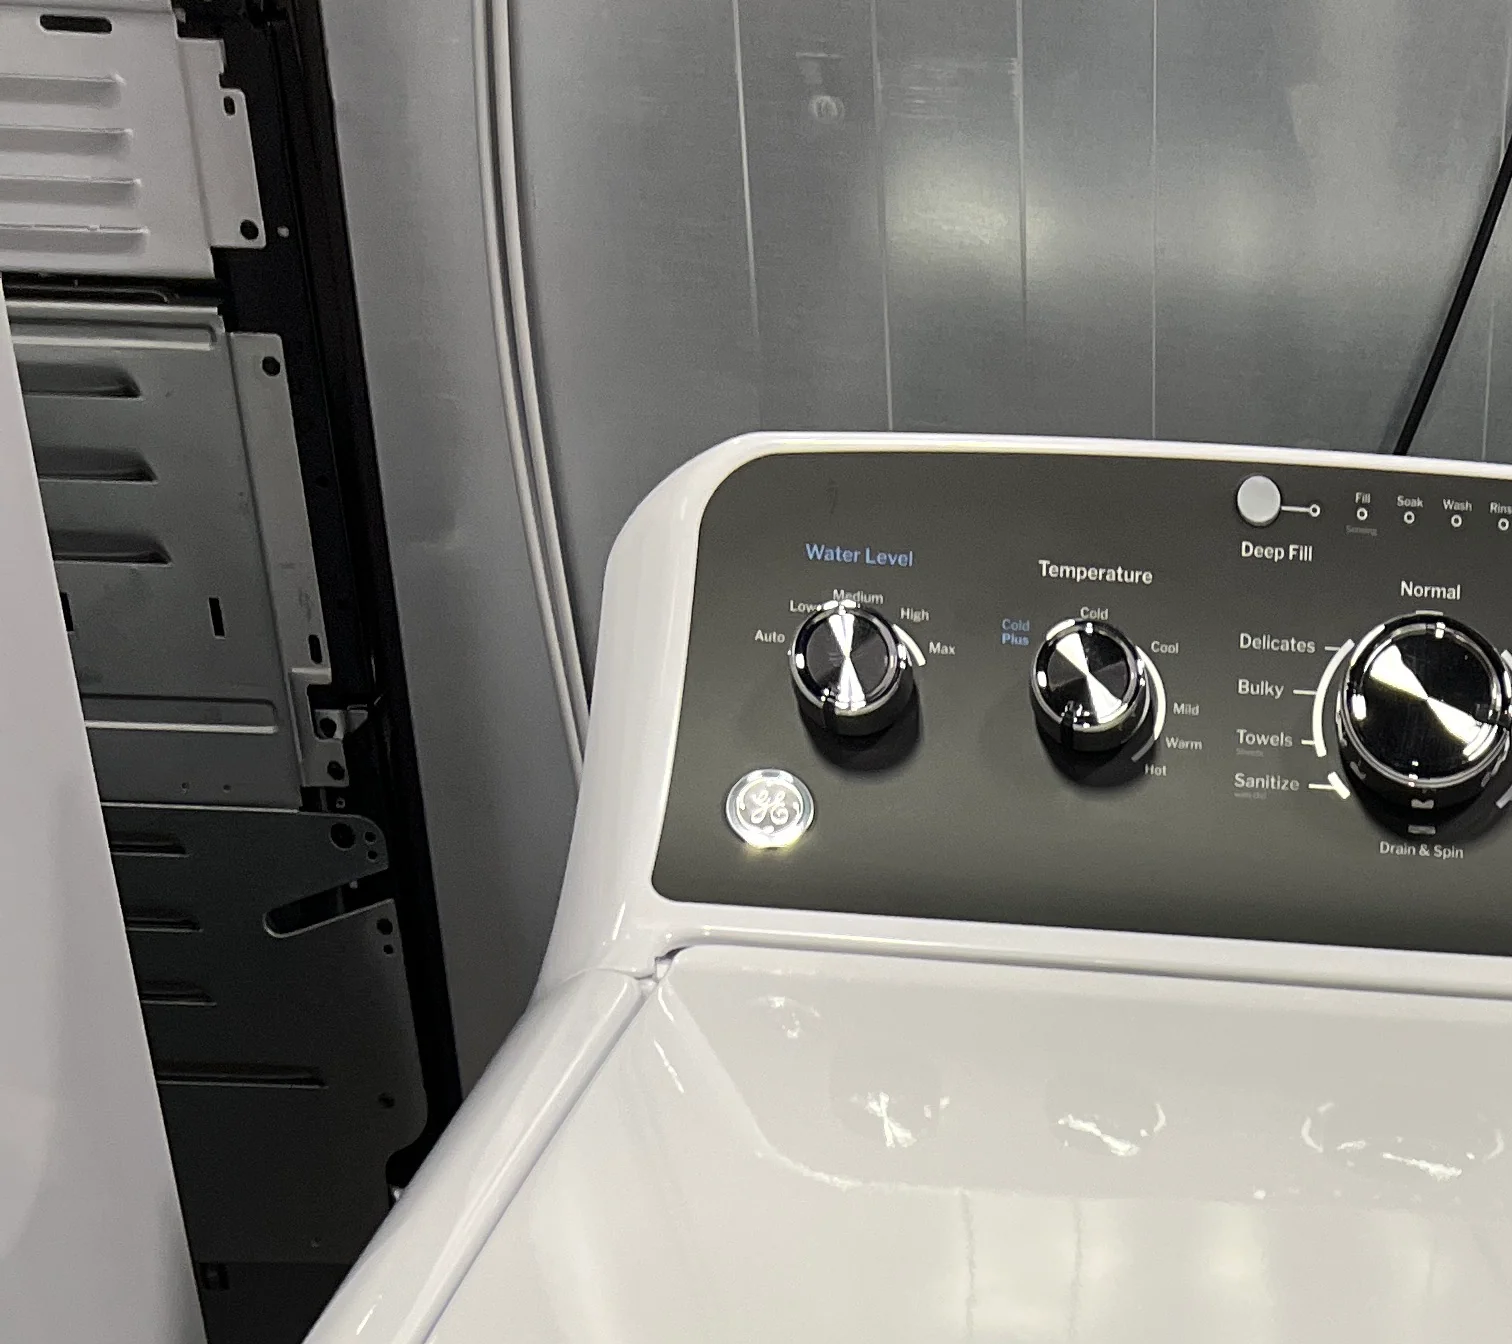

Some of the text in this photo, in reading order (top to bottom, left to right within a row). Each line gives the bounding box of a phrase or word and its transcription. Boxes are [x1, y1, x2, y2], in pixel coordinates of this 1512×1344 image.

[1355, 492, 1371, 503] Fill
[1397, 495, 1424, 508] Soak
[1442, 499, 1473, 512] Wash
[805, 543, 914, 567] Water Level
[1241, 541, 1313, 563] Deep Fill
[1038, 560, 1154, 585] Temperature
[833, 589, 884, 604] Medium
[1400, 580, 1461, 600] Normal
[789, 600, 816, 613] Low
[1080, 606, 1109, 621] Cold
[900, 608, 930, 623] High
[1001, 618, 1030, 632] Cold
[754, 629, 786, 644] Auto
[1001, 632, 1029, 646] Plus
[1239, 632, 1316, 654] Delicates
[928, 641, 956, 655] Max
[1151, 640, 1179, 654] Cool
[1237, 678, 1285, 700] Bulky
[1173, 702, 1200, 716] Mild
[1165, 736, 1203, 750] Warm
[1236, 728, 1293, 748] Towels
[1144, 763, 1167, 777] Hot
[1234, 772, 1300, 792] Sanitize
[1379, 840, 1464, 860] Drain & Spin
